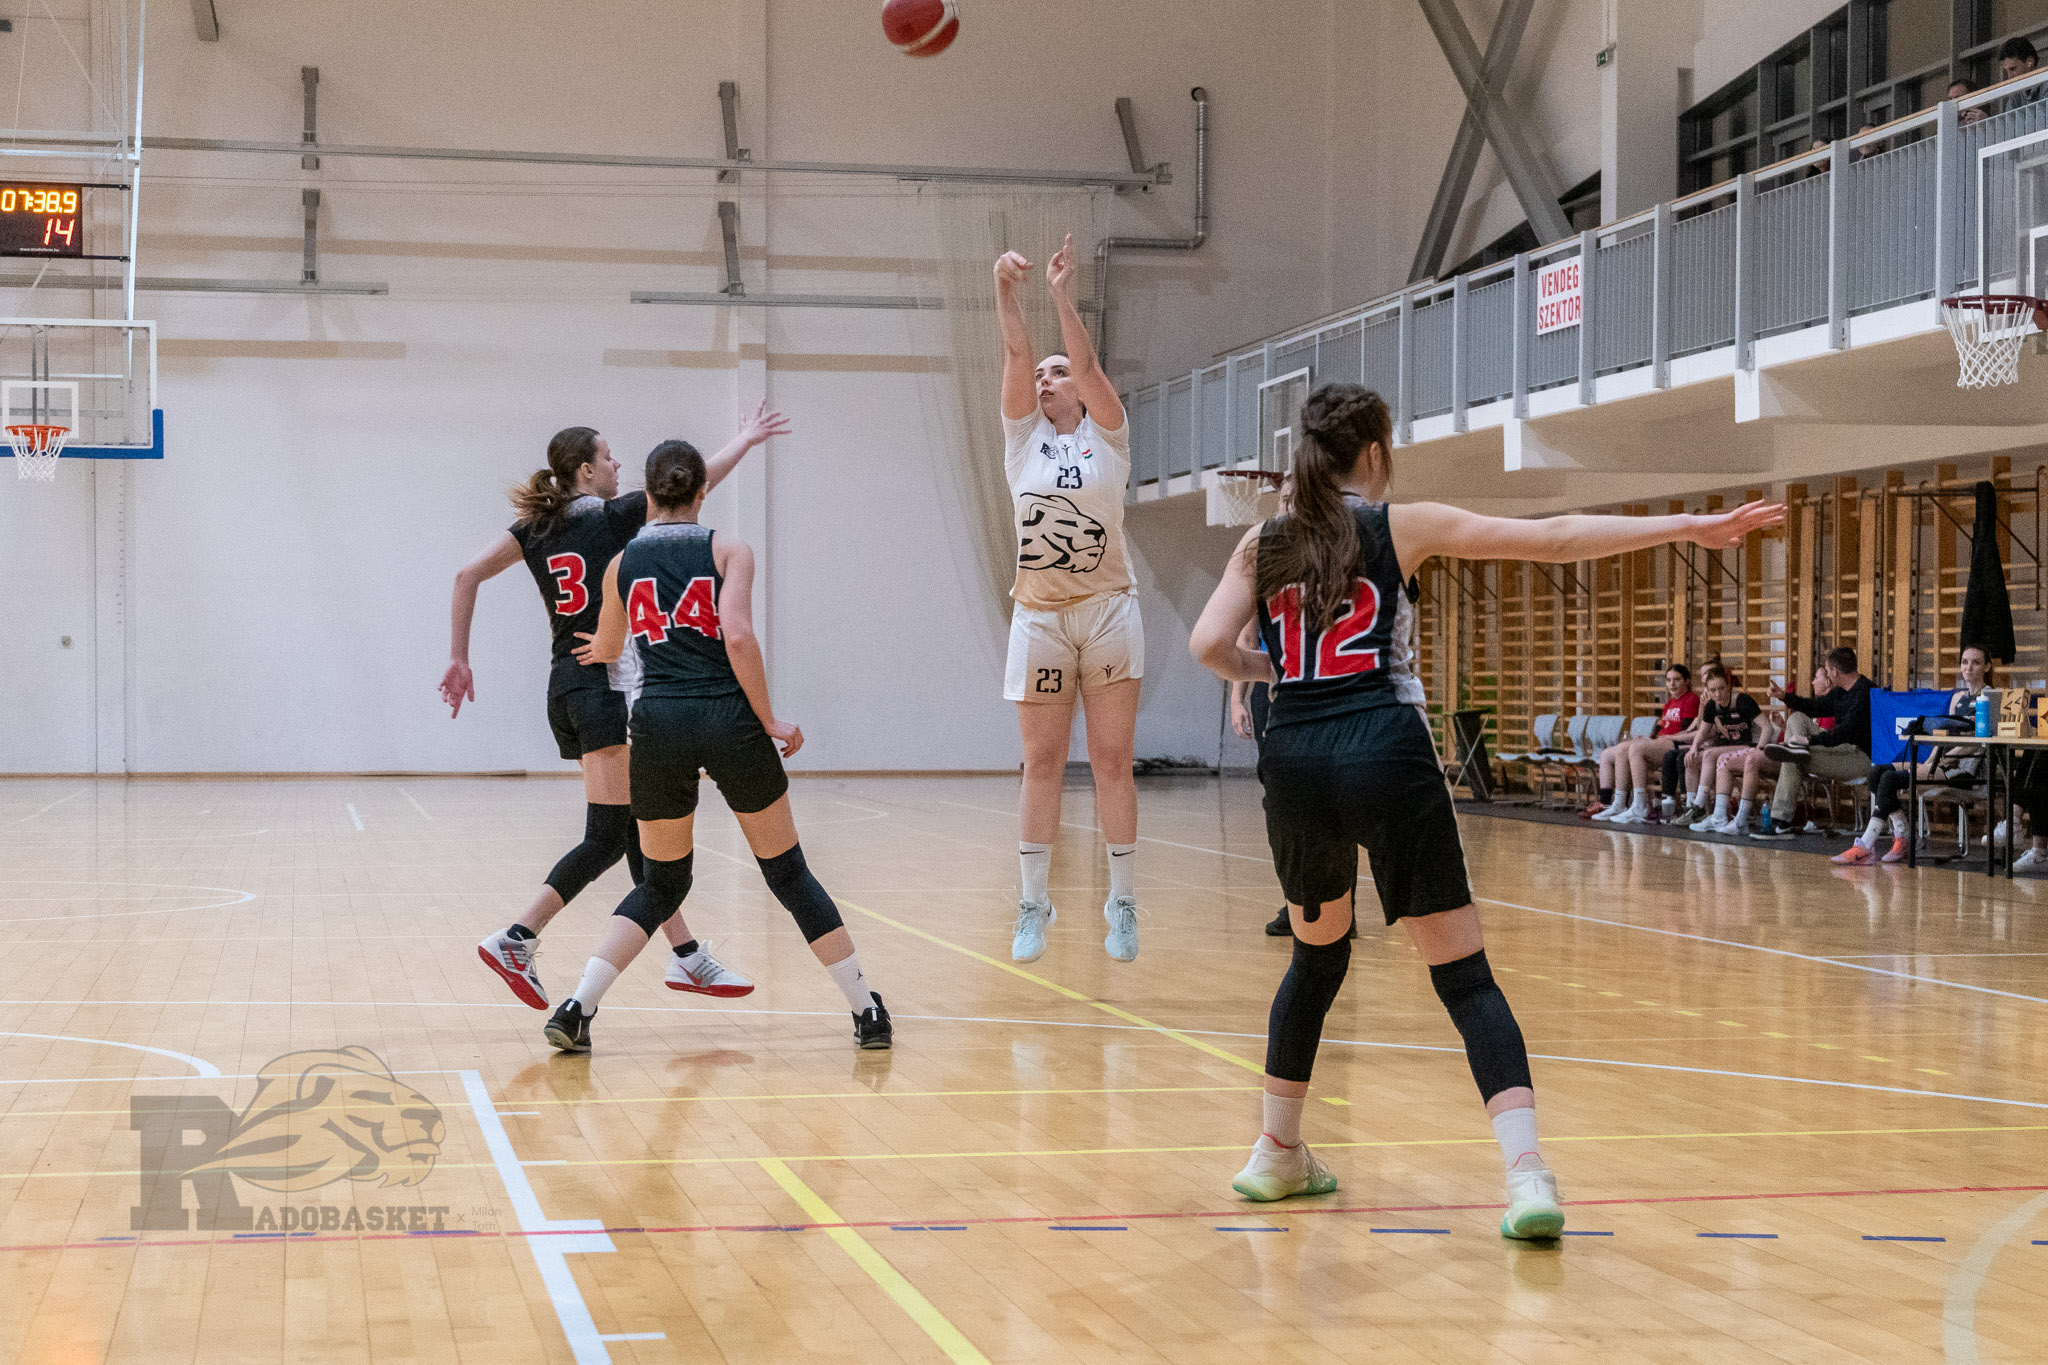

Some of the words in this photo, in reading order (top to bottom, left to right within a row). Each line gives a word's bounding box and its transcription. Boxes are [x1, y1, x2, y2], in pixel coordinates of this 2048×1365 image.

[1, 189, 77, 214] 07:38.9
[43, 218, 75, 247] 14
[1541, 262, 1579, 298] VENDÉG
[1538, 295, 1581, 330] SZEKTOR
[1056, 465, 1083, 489] 23
[547, 552, 589, 616] 3
[626, 576, 723, 646] 44
[1266, 576, 1381, 684] 12
[1036, 668, 1062, 693] 23
